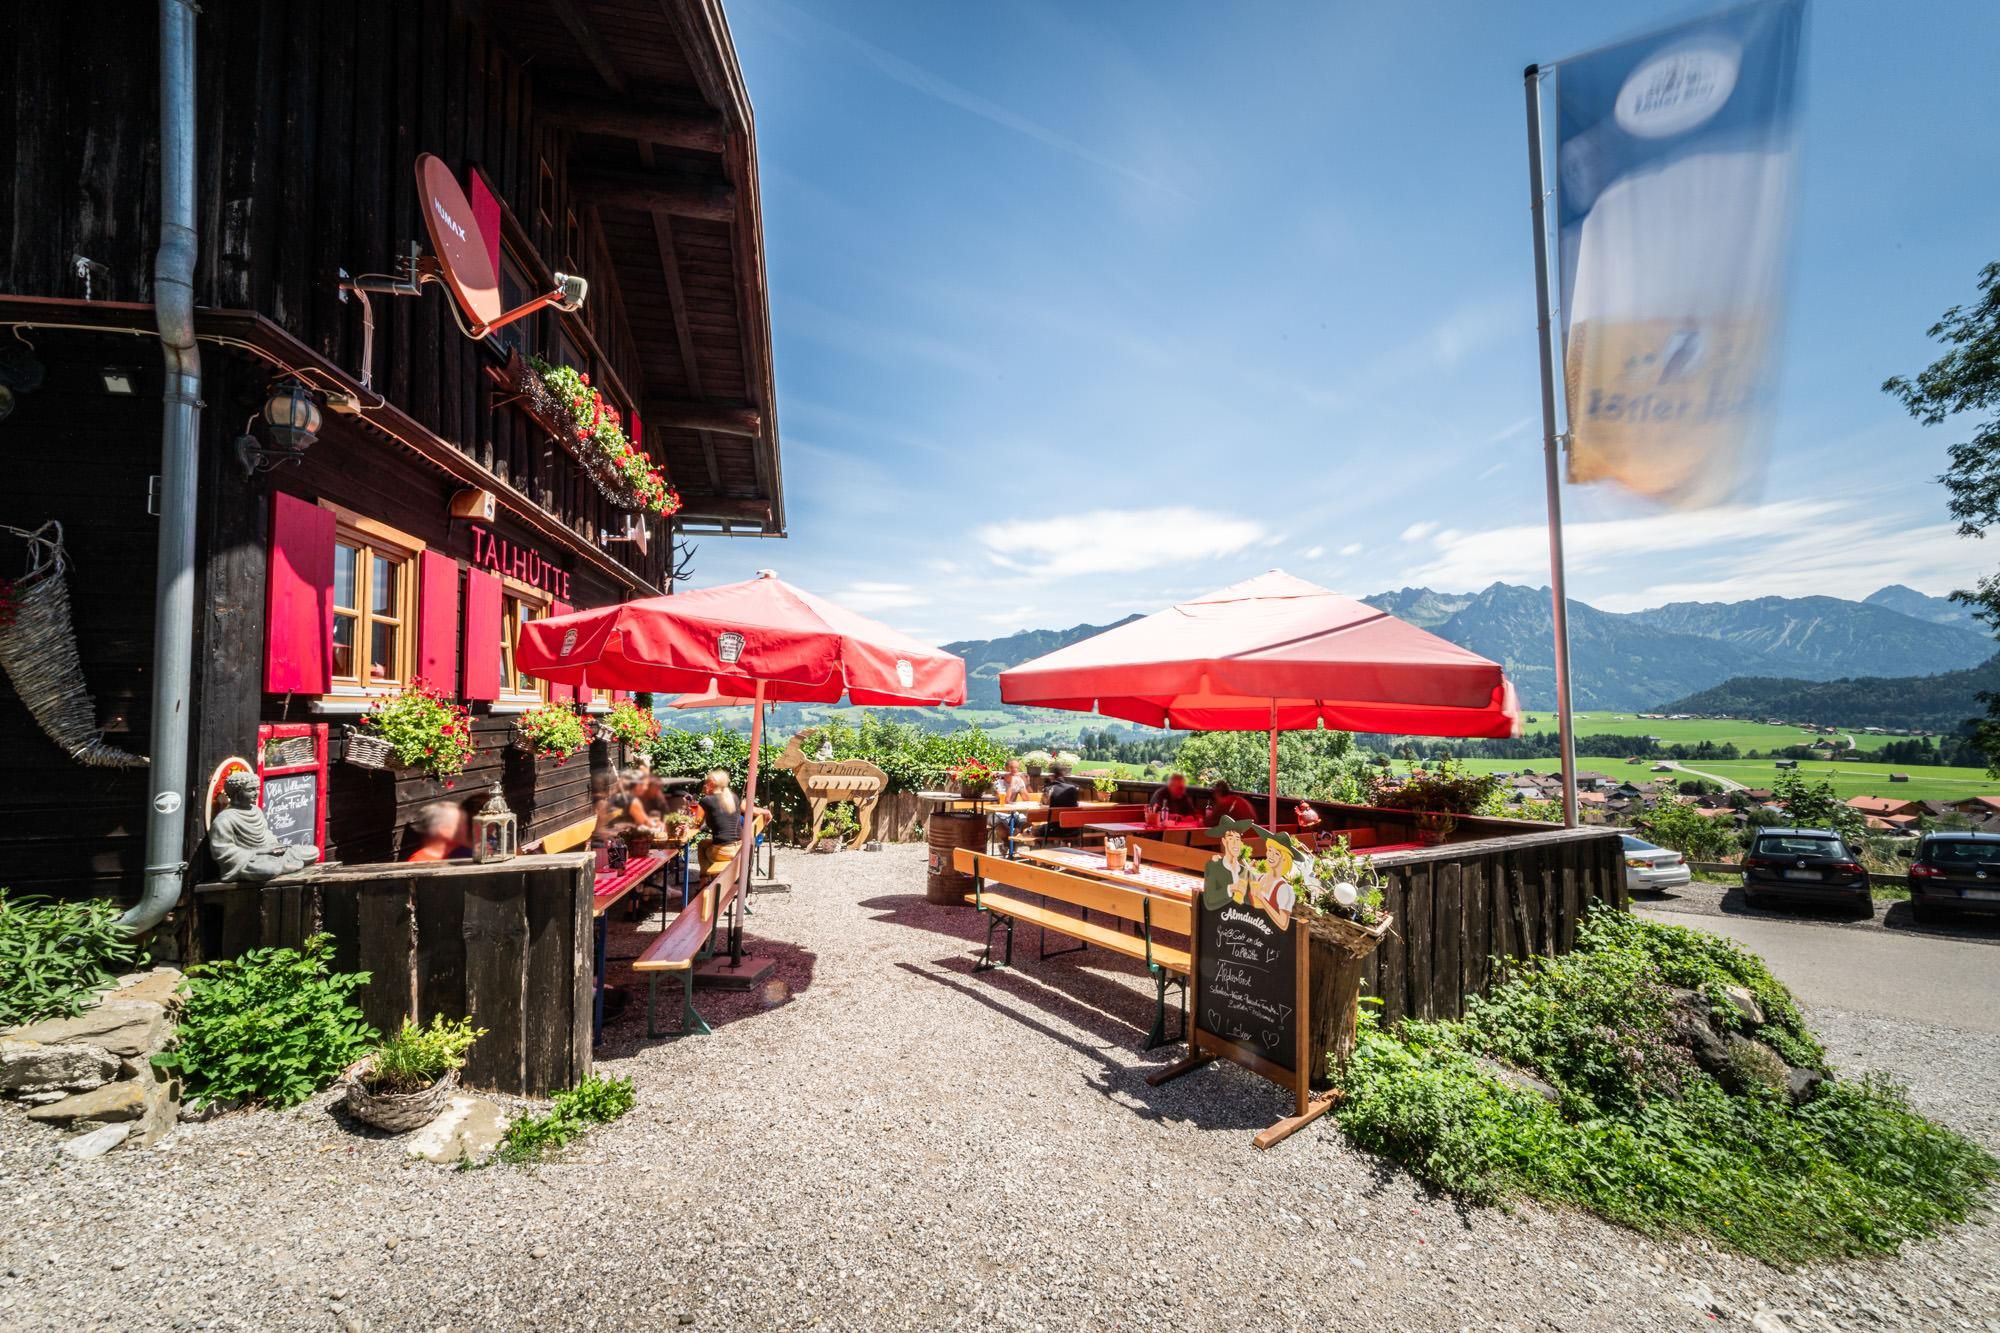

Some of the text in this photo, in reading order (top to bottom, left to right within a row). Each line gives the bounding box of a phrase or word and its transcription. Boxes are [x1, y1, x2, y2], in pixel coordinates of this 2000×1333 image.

[434, 196, 466, 242] HUMAX
[471, 525, 571, 600] TALHÜTTE
[819, 763, 868, 777] Talhütte
[1221, 907, 1272, 935] Almdudler
